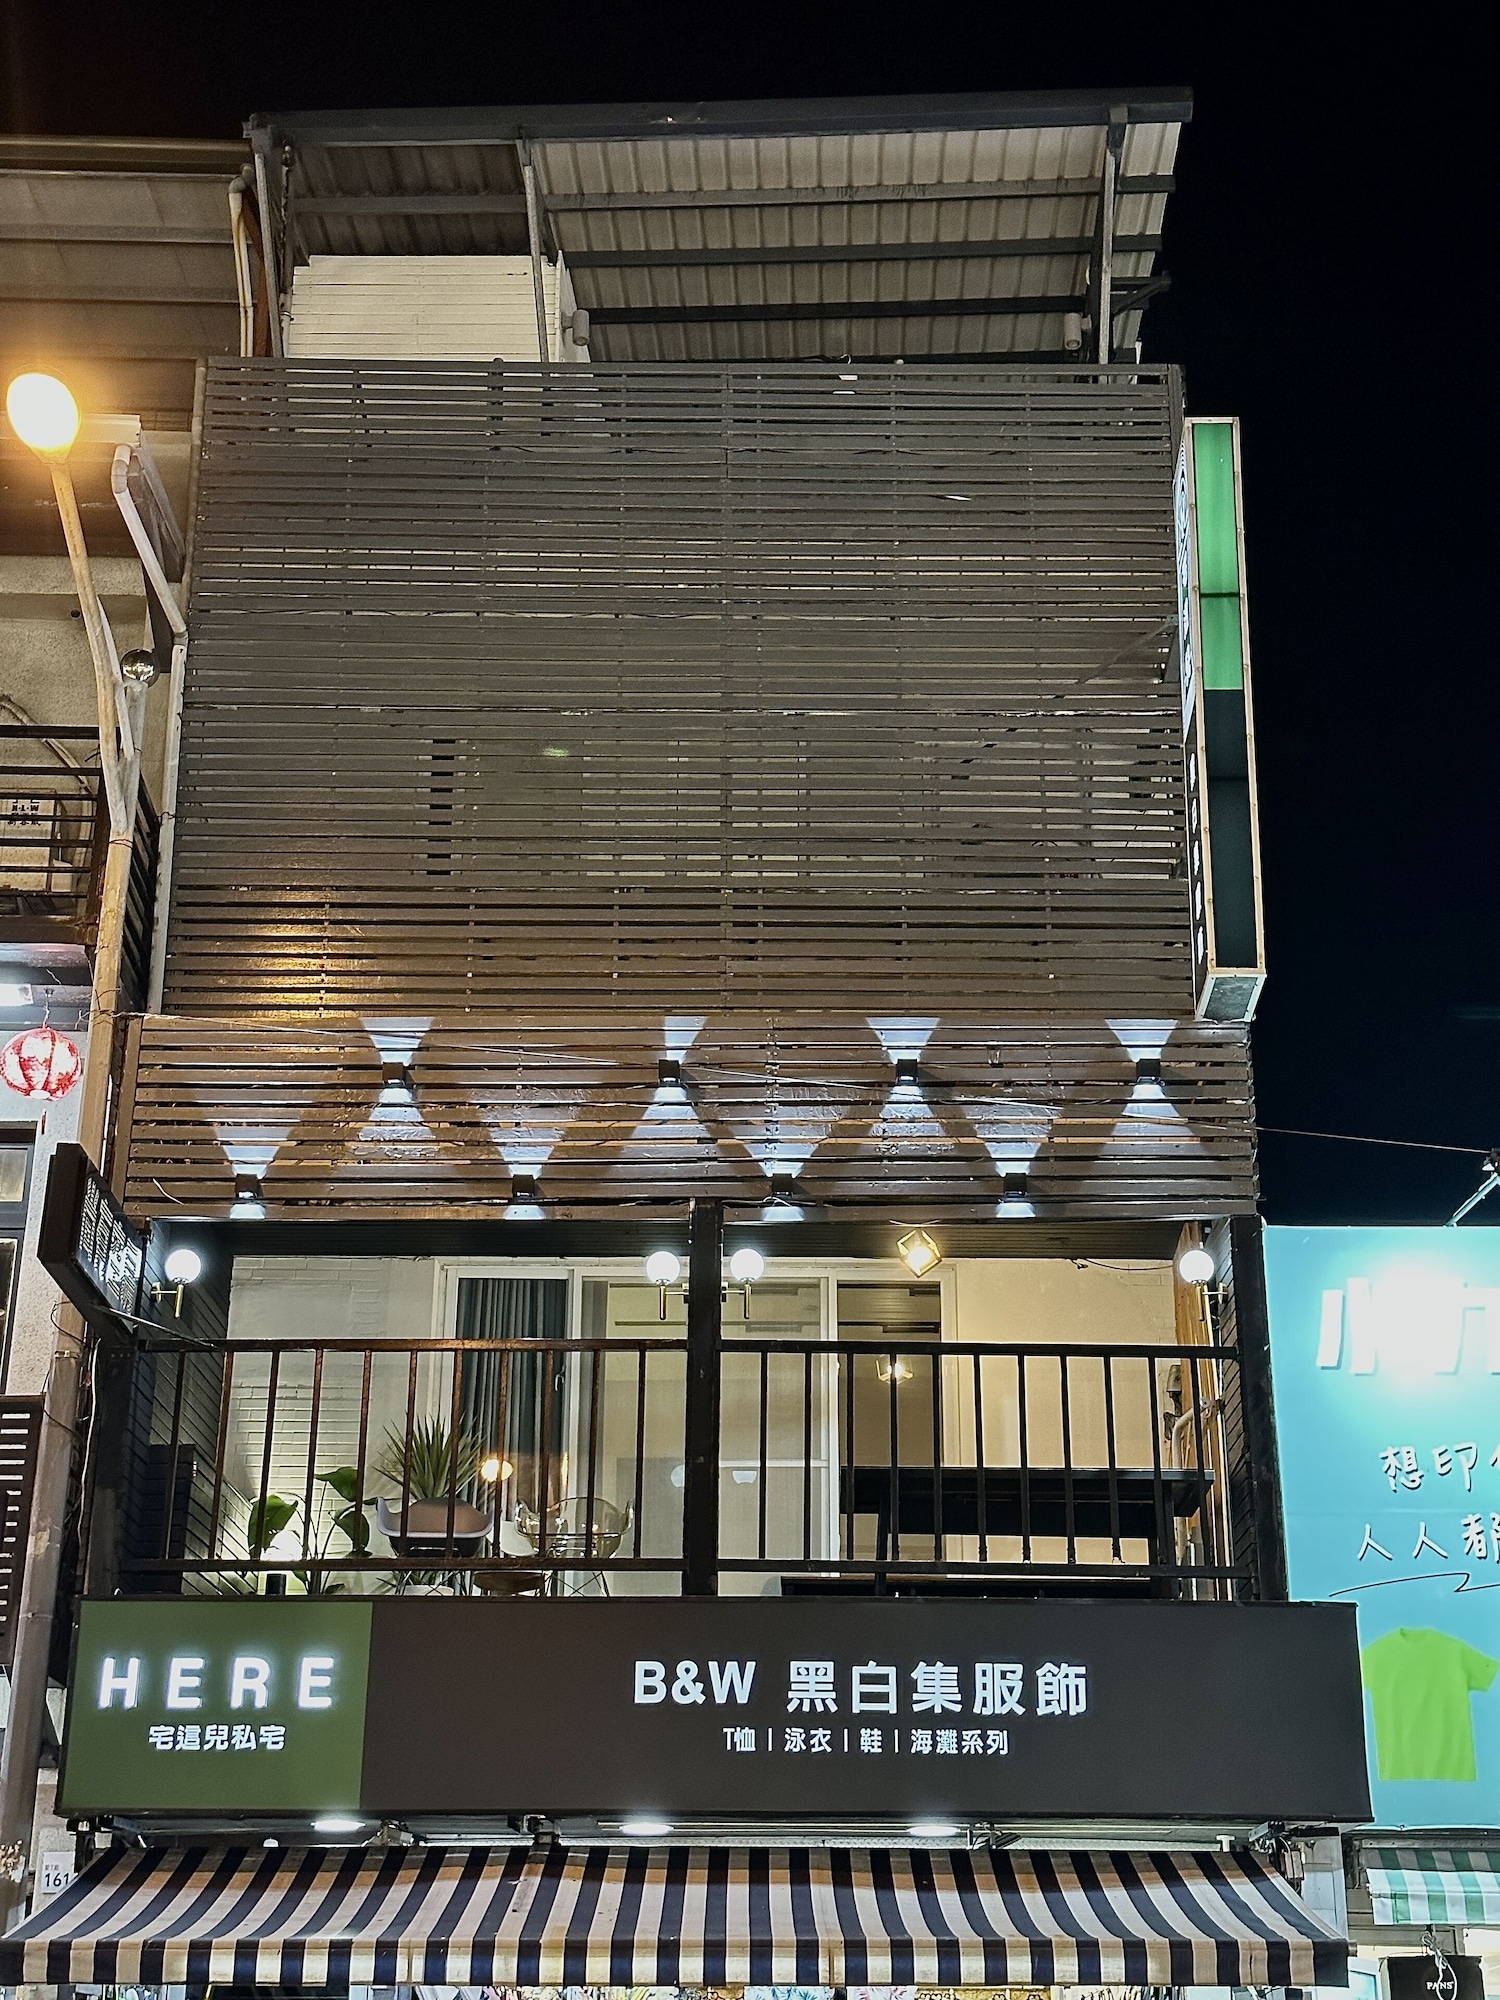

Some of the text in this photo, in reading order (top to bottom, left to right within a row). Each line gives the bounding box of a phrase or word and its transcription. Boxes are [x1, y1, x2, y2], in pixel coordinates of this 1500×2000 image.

[97, 1656, 336, 1710] HERE
[634, 1660, 1088, 1716] B&W 黑白集服飾
[148, 1724, 286, 1751] 宅這兒私宅
[722, 1727, 1009, 1755] T恤 泳衣 鞋 海灘系列
[44, 1872, 69, 1887] 161
